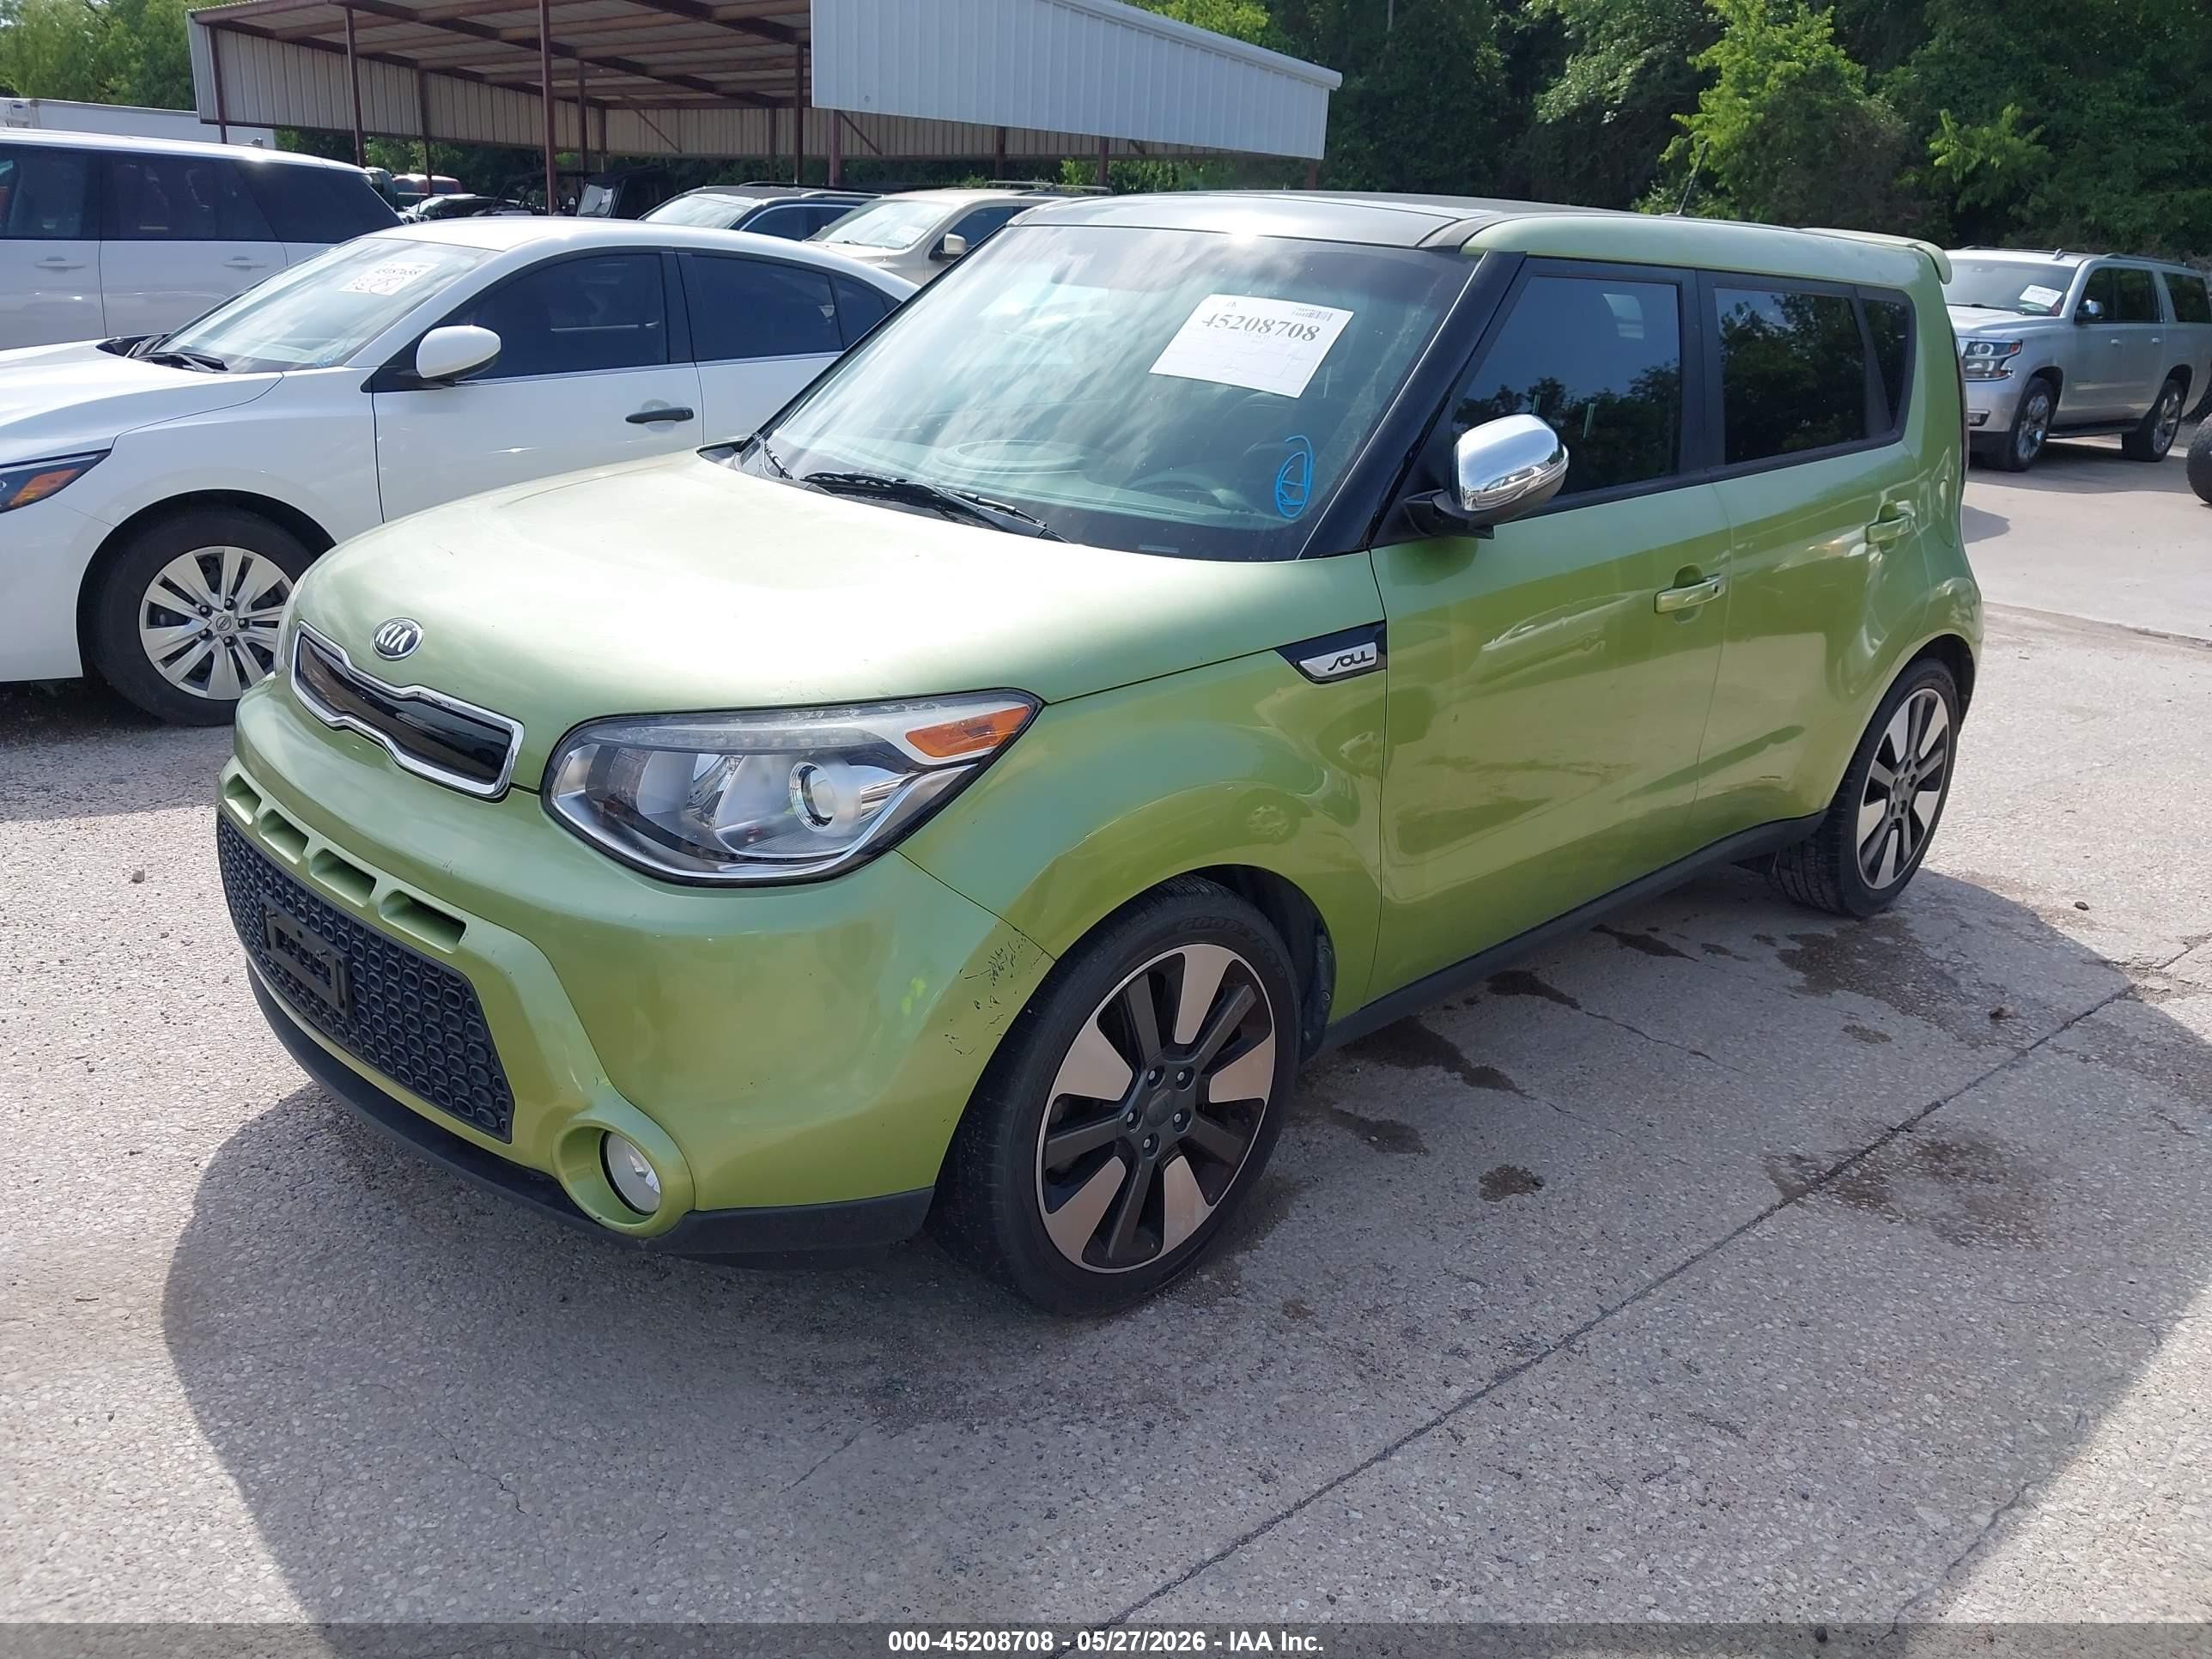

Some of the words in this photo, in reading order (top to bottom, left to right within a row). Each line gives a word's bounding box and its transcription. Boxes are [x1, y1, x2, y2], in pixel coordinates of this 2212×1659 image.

[1201, 313, 1322, 342] 45208708
[375, 621, 413, 653] KIA
[1327, 650, 1375, 672] SOUL
